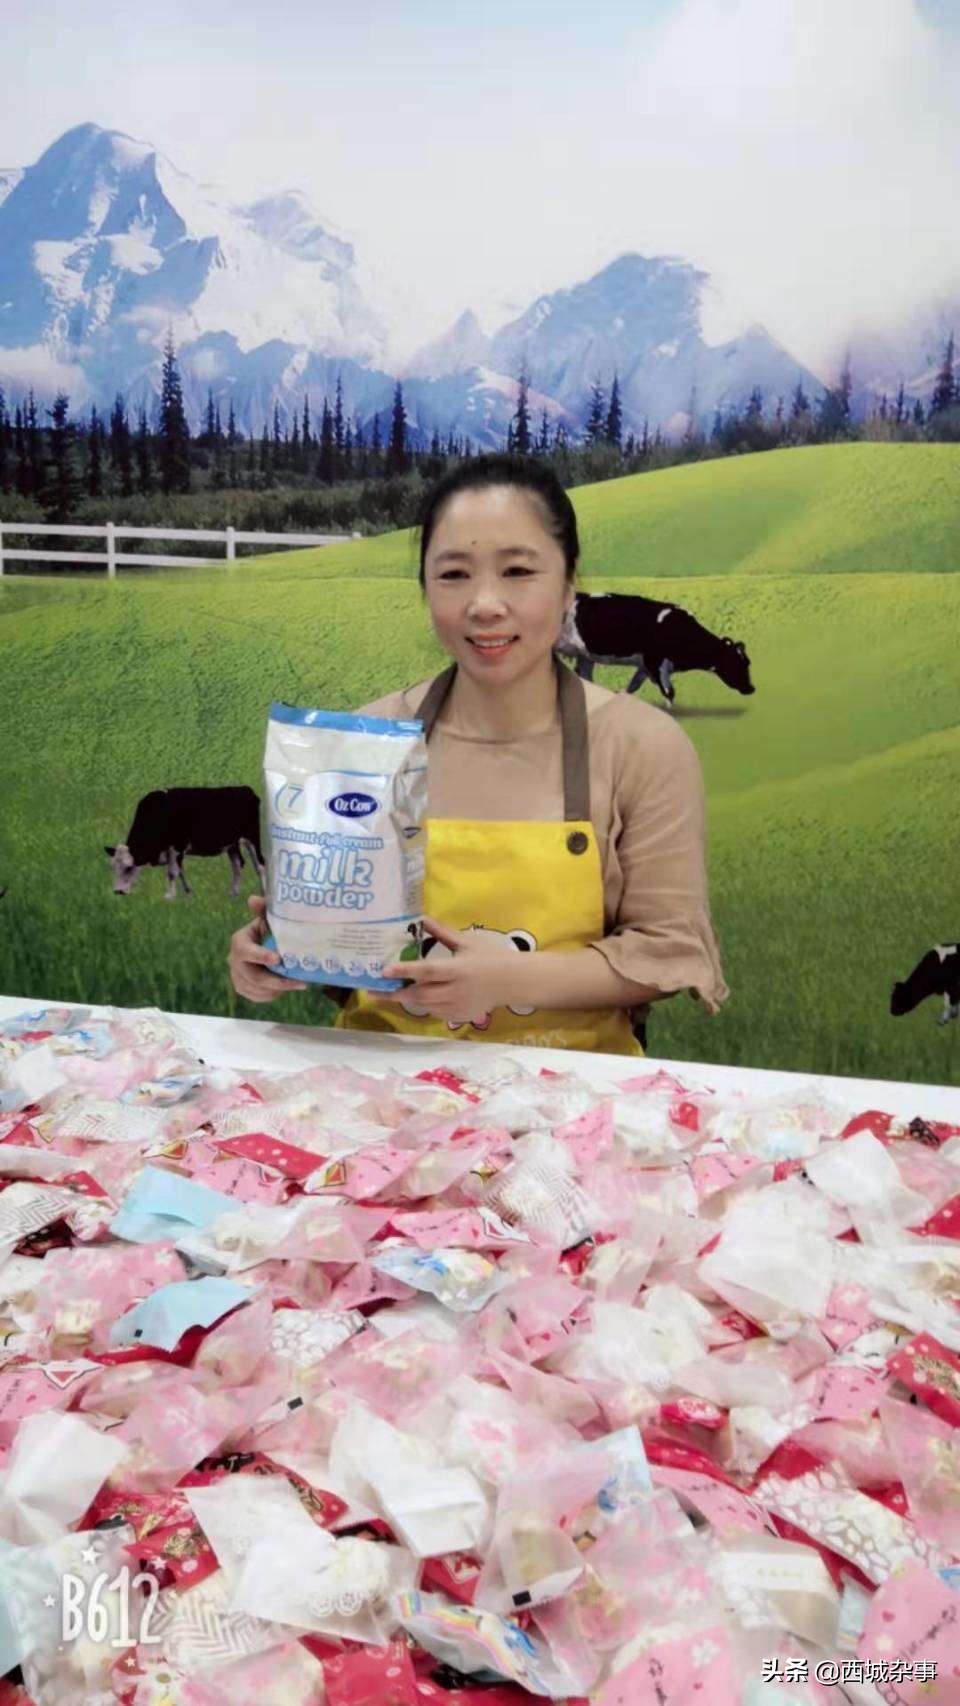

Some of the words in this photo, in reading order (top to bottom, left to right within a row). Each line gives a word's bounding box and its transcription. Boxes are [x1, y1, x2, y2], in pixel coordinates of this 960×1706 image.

[288, 786, 303, 808] 7
[334, 798, 348, 812] Oz
[350, 798, 372, 812] Cow
[343, 836, 384, 850] cream
[279, 848, 374, 887] milk
[277, 881, 375, 910] powder
